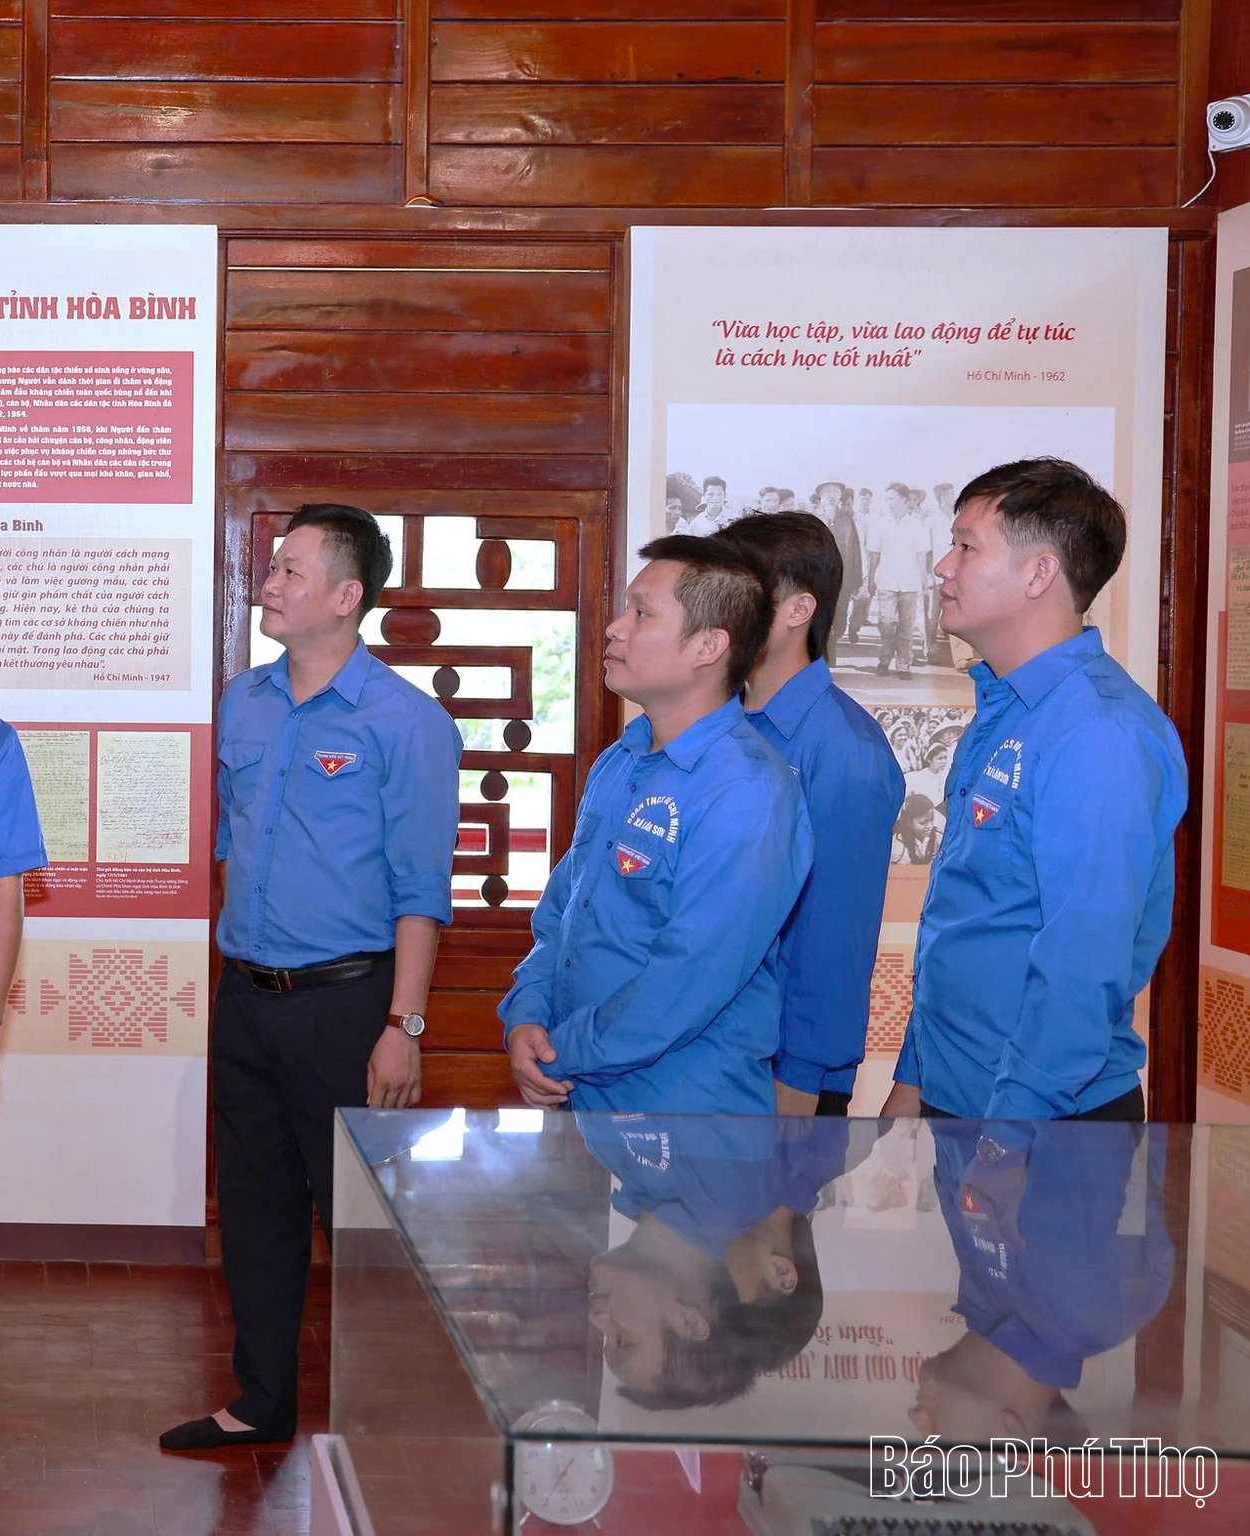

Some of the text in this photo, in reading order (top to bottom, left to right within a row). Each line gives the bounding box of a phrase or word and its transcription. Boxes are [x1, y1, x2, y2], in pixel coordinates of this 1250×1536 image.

[66, 291, 121, 320] HÒA
[128, 291, 196, 320] BÌNH
[765, 320, 801, 343] học
[806, 320, 844, 343] tập,
[851, 320, 888, 340] vừa
[893, 321, 925, 340] lao
[931, 321, 982, 344] động
[986, 318, 1016, 340] để
[1016, 323, 1041, 345] tự
[1043, 321, 1076, 341] túc
[715, 347, 735, 366] là
[740, 347, 787, 366] cách
[791, 349, 827, 371] học
[832, 346, 860, 367] tốt
[966, 369, 982, 380] Hồ
[983, 370, 1002, 381] Chí
[1003, 370, 1031, 381] Minh
[1040, 370, 1065, 382] 1962
[12, 519, 44, 532] Bình
[666, 818, 679, 844] MINH
